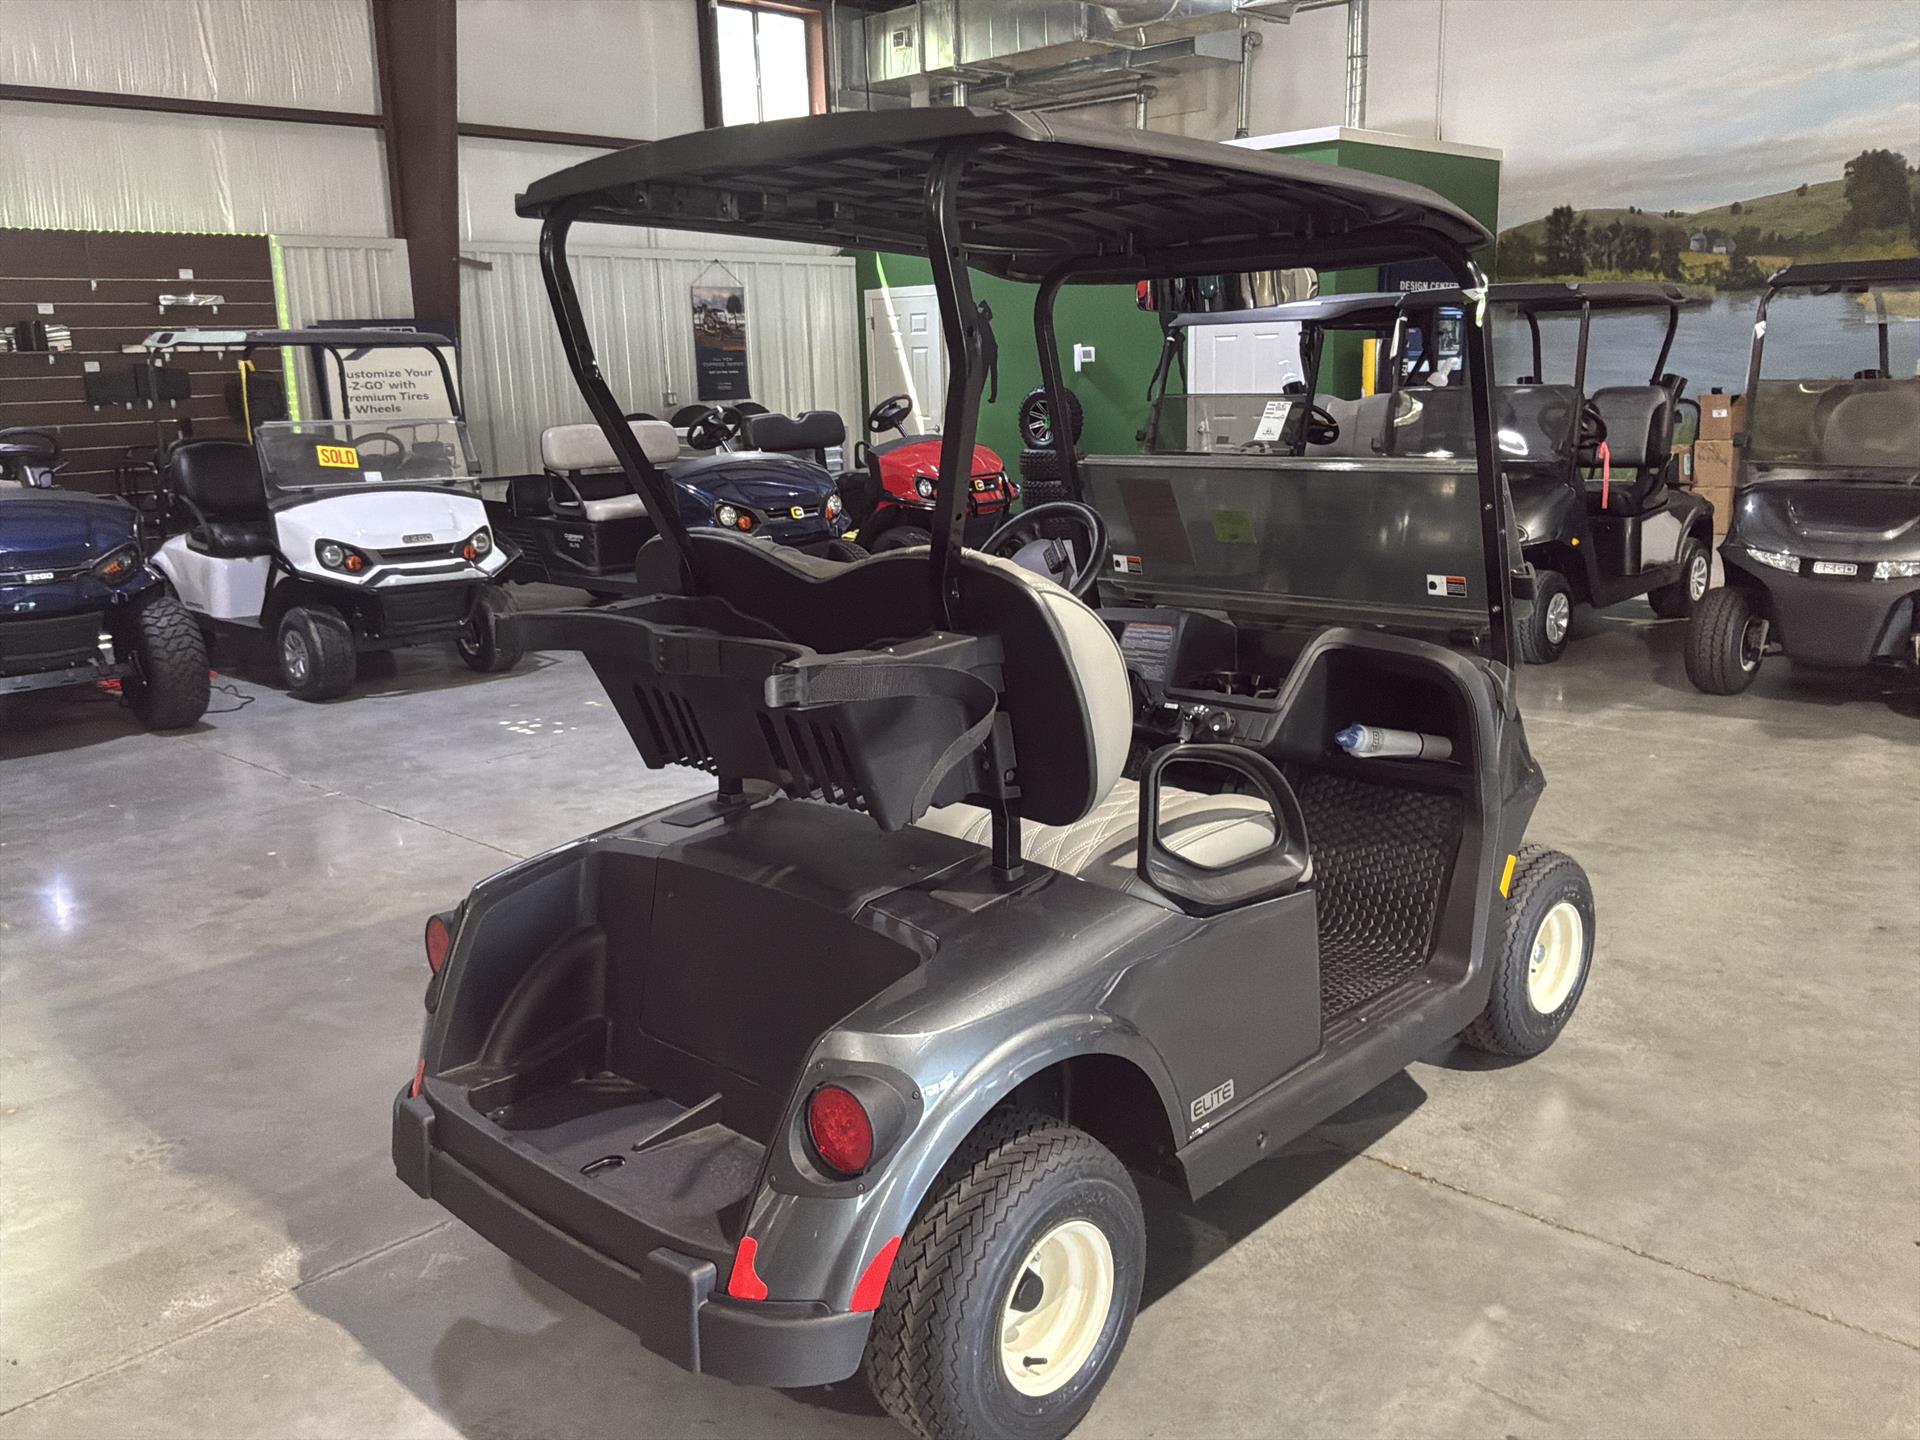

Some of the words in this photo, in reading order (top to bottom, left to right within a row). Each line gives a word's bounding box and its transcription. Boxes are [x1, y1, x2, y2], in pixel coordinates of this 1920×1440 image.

[1400, 281, 1428, 291] DESIGN
[346, 370, 401, 379] ustomize
[404, 368, 433, 377] Your
[389, 380, 417, 389] with
[349, 394, 397, 402] remium
[399, 391, 430, 401] Tires
[355, 404, 402, 414] Wheels
[320, 448, 355, 465] SOLD
